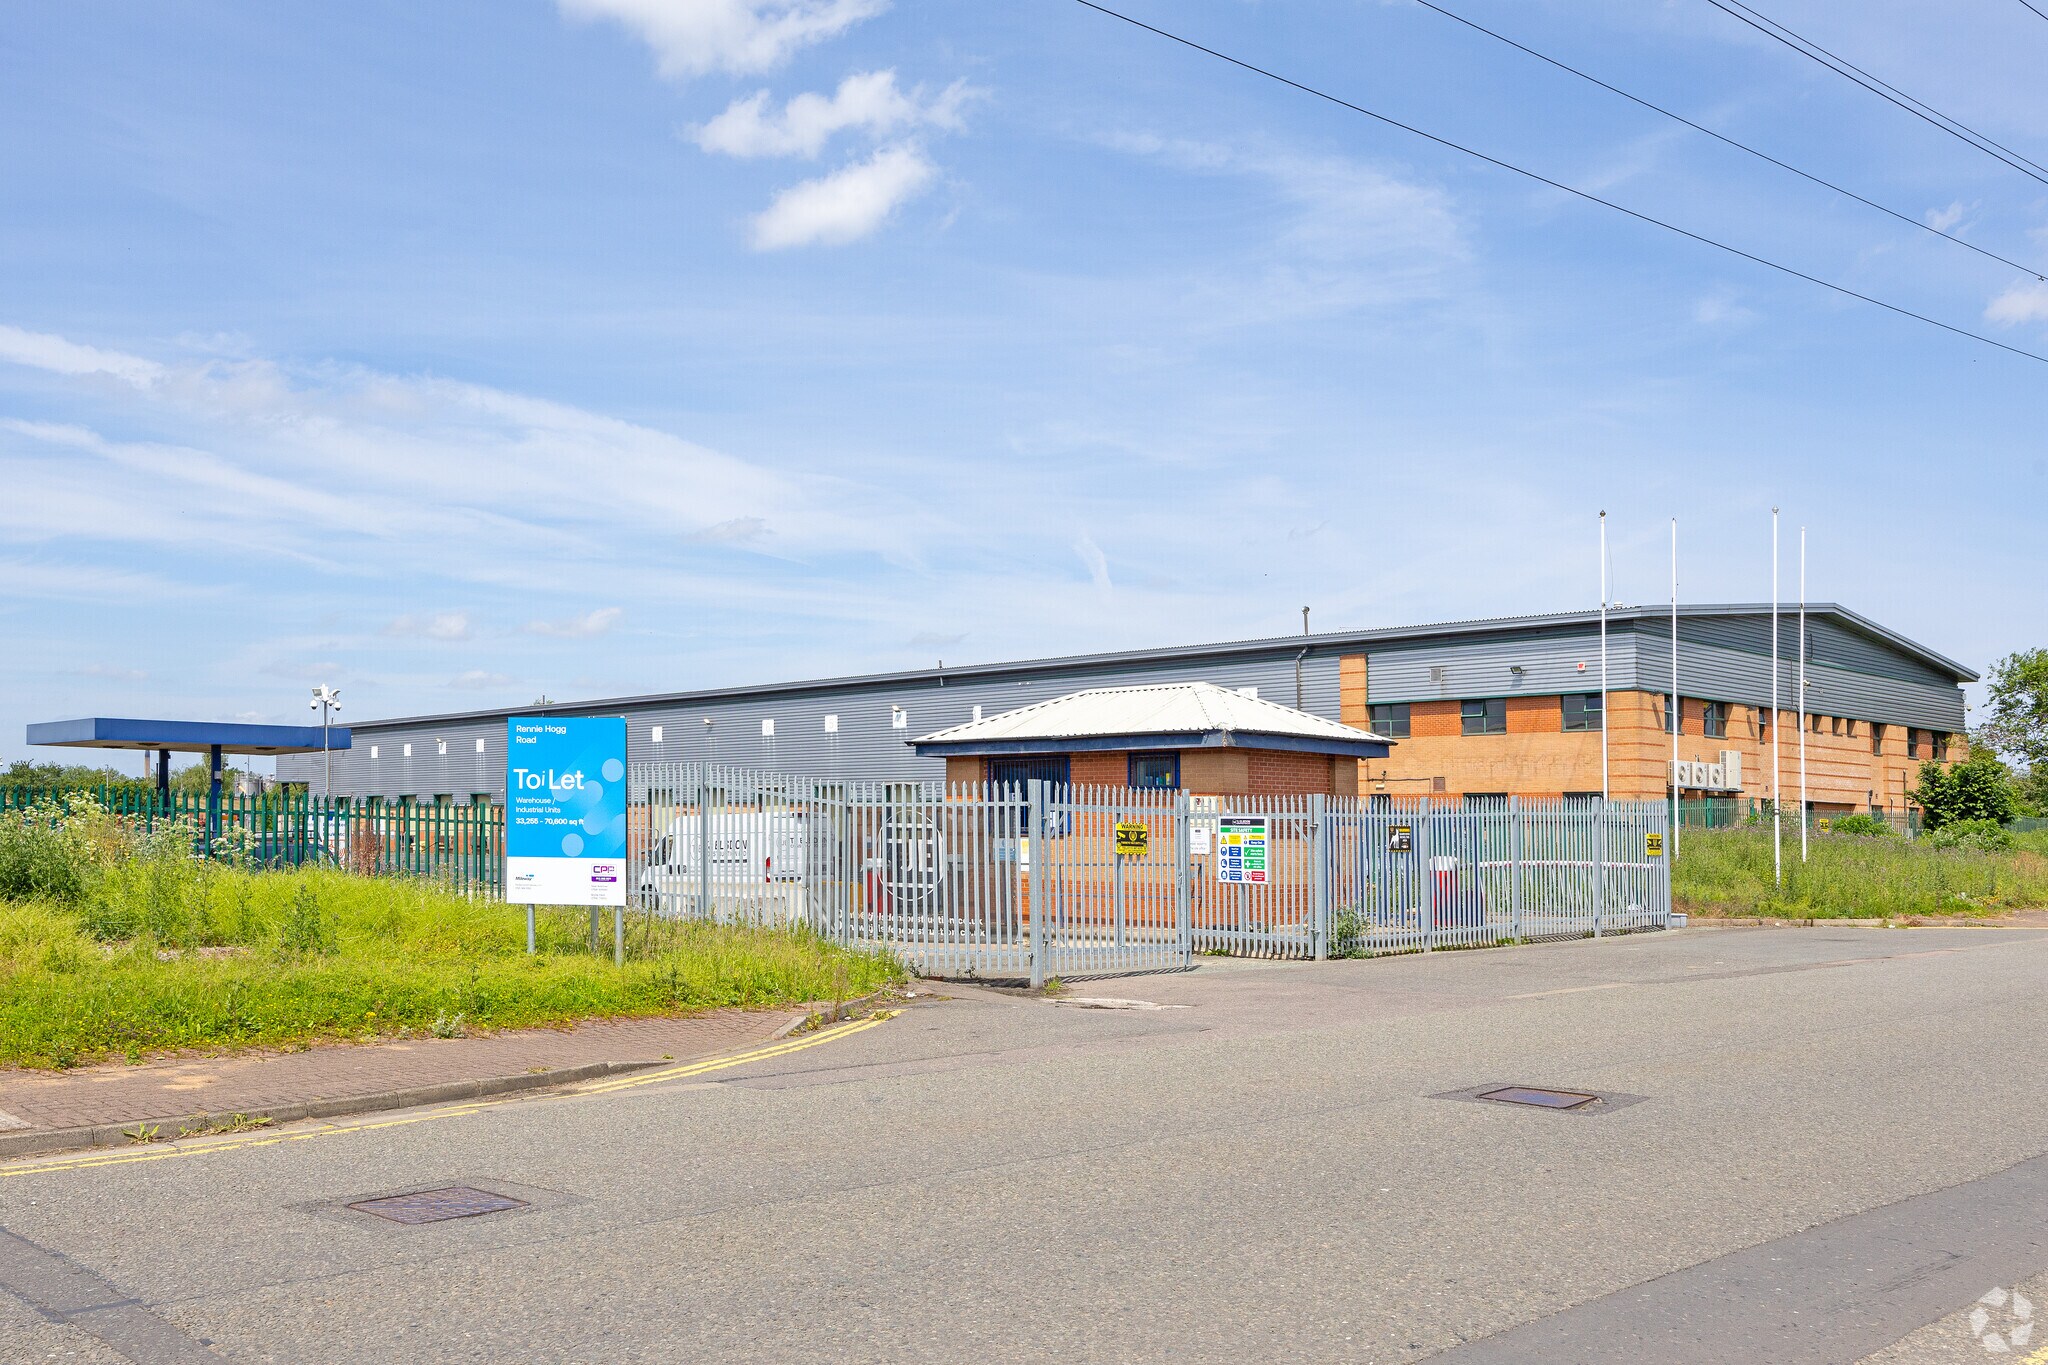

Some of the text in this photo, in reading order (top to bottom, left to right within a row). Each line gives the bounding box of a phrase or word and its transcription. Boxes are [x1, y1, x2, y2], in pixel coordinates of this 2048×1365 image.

[516, 725, 567, 734] Rennie Hogg
[516, 736, 537, 744] Road
[549, 769, 584, 790] Let
[552, 797, 556, 805] /
